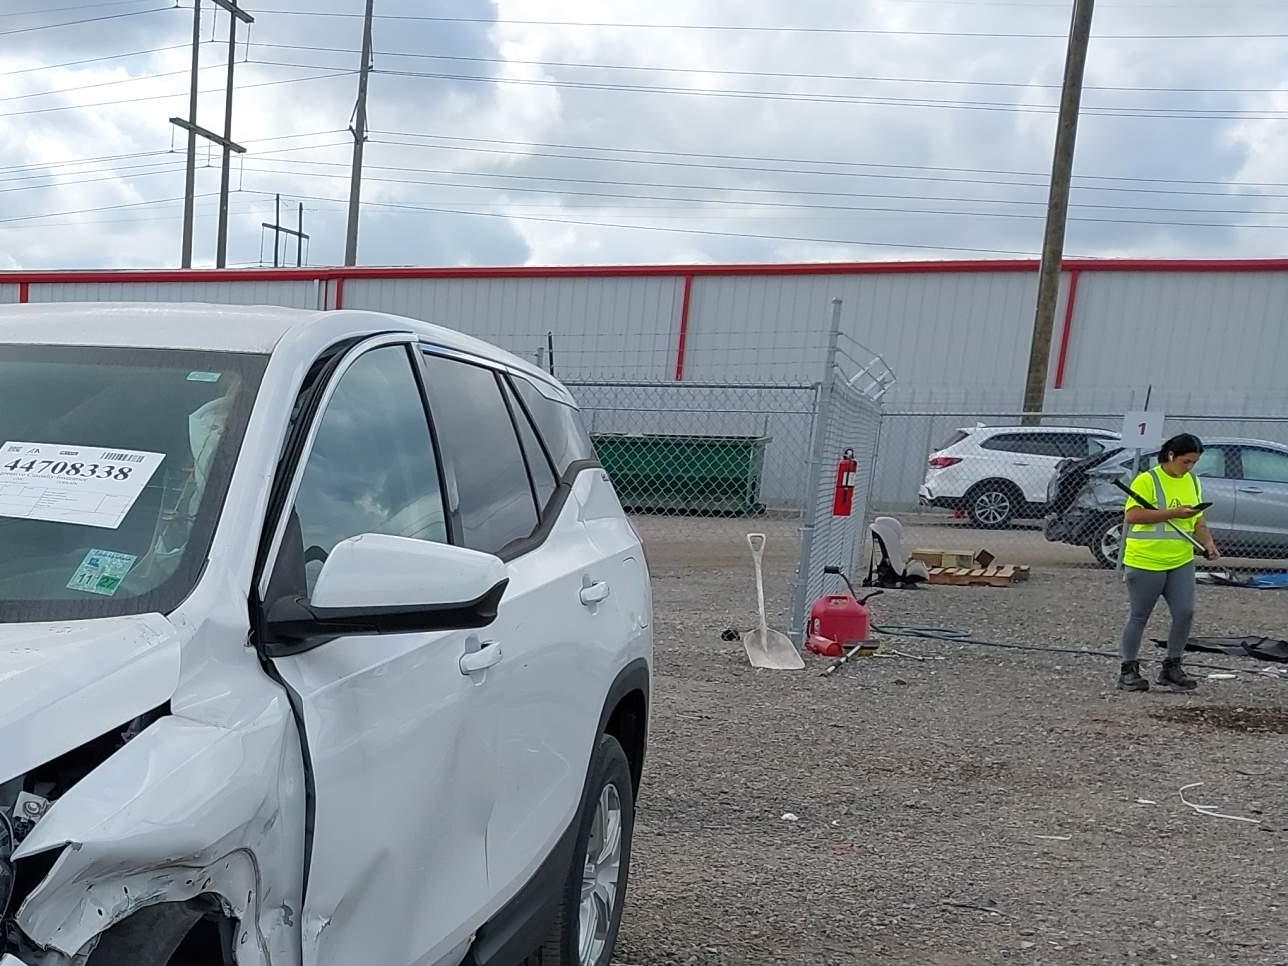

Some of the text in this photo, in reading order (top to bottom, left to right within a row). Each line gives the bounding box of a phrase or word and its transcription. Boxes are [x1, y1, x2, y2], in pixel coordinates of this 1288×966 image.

[1138, 422, 1147, 436] 1
[4, 457, 133, 481] 44708338
[78, 573, 117, 589] 11 27
